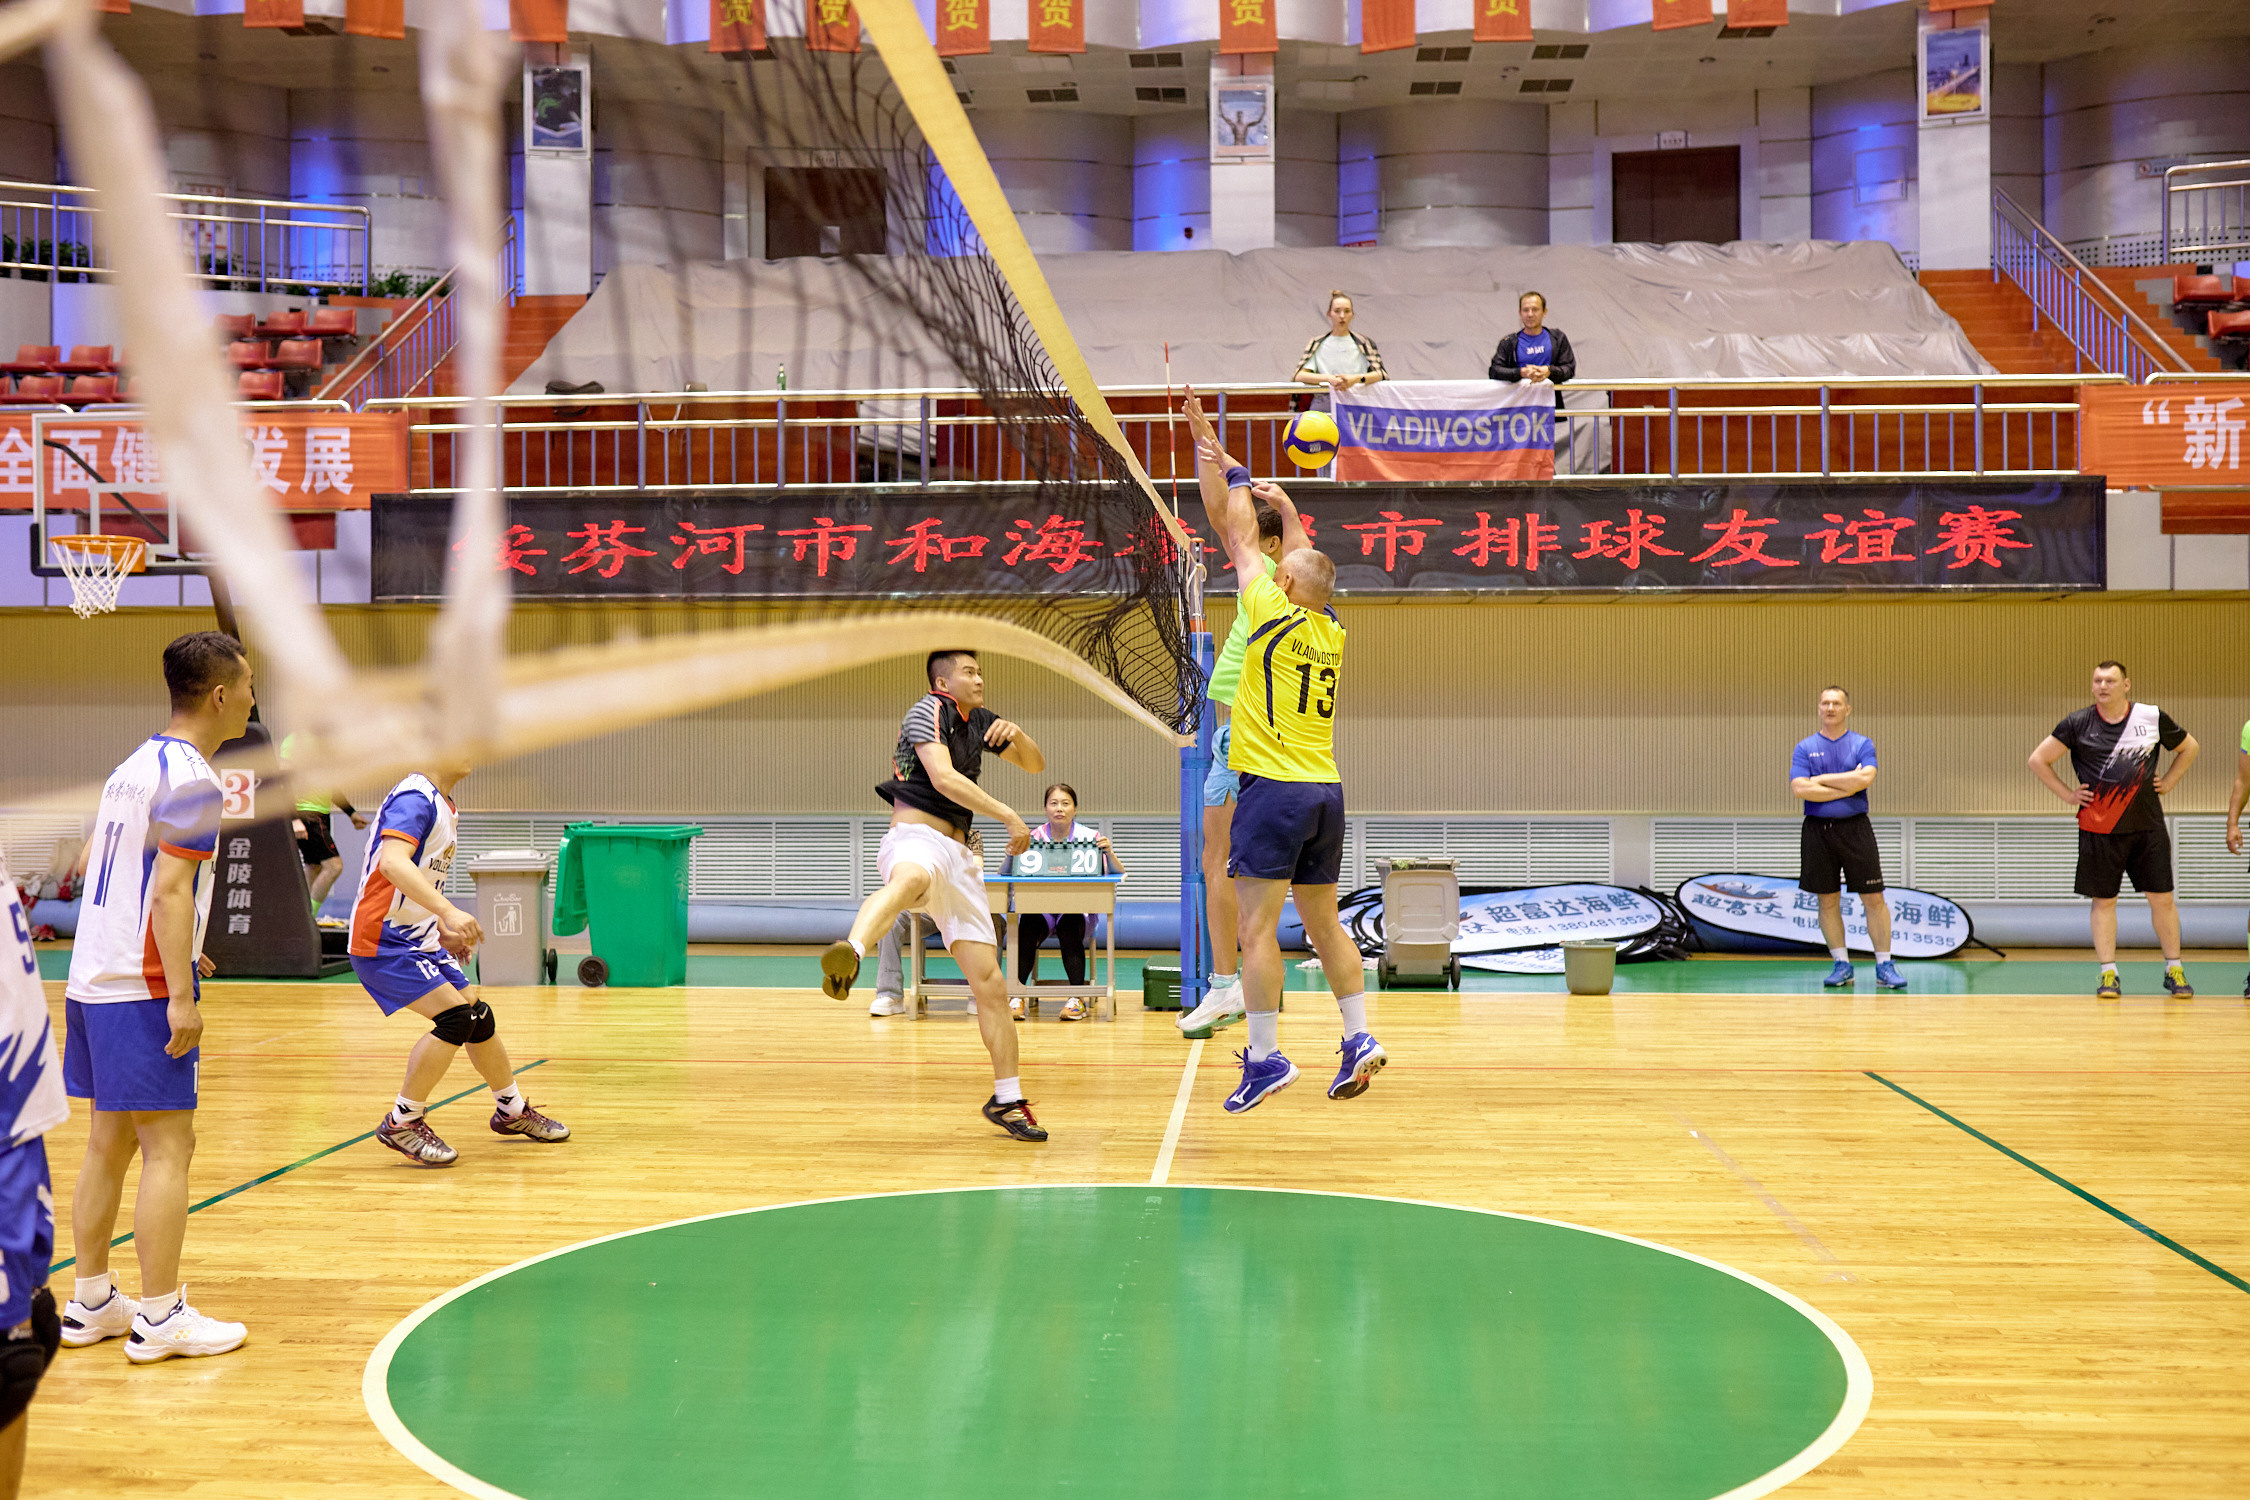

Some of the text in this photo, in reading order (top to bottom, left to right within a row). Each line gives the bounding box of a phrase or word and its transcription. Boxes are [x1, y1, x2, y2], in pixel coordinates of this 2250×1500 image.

[945, 0, 979, 30] 贺
[1039, 0, 1073, 28] 贺
[1347, 411, 1550, 447] VLADIVOSTOK
[0, 426, 354, 495] 全面健发展
[1296, 662, 1336, 719] 13
[2134, 725, 2147, 737] 10
[223, 773, 251, 815] 3
[93, 821, 125, 908] 11
[1019, 850, 1098, 874] 9 20
[226, 837, 252, 935] 金陵体育
[1485, 892, 1640, 924] 超富达海鲜
[415, 958, 440, 981] 12
